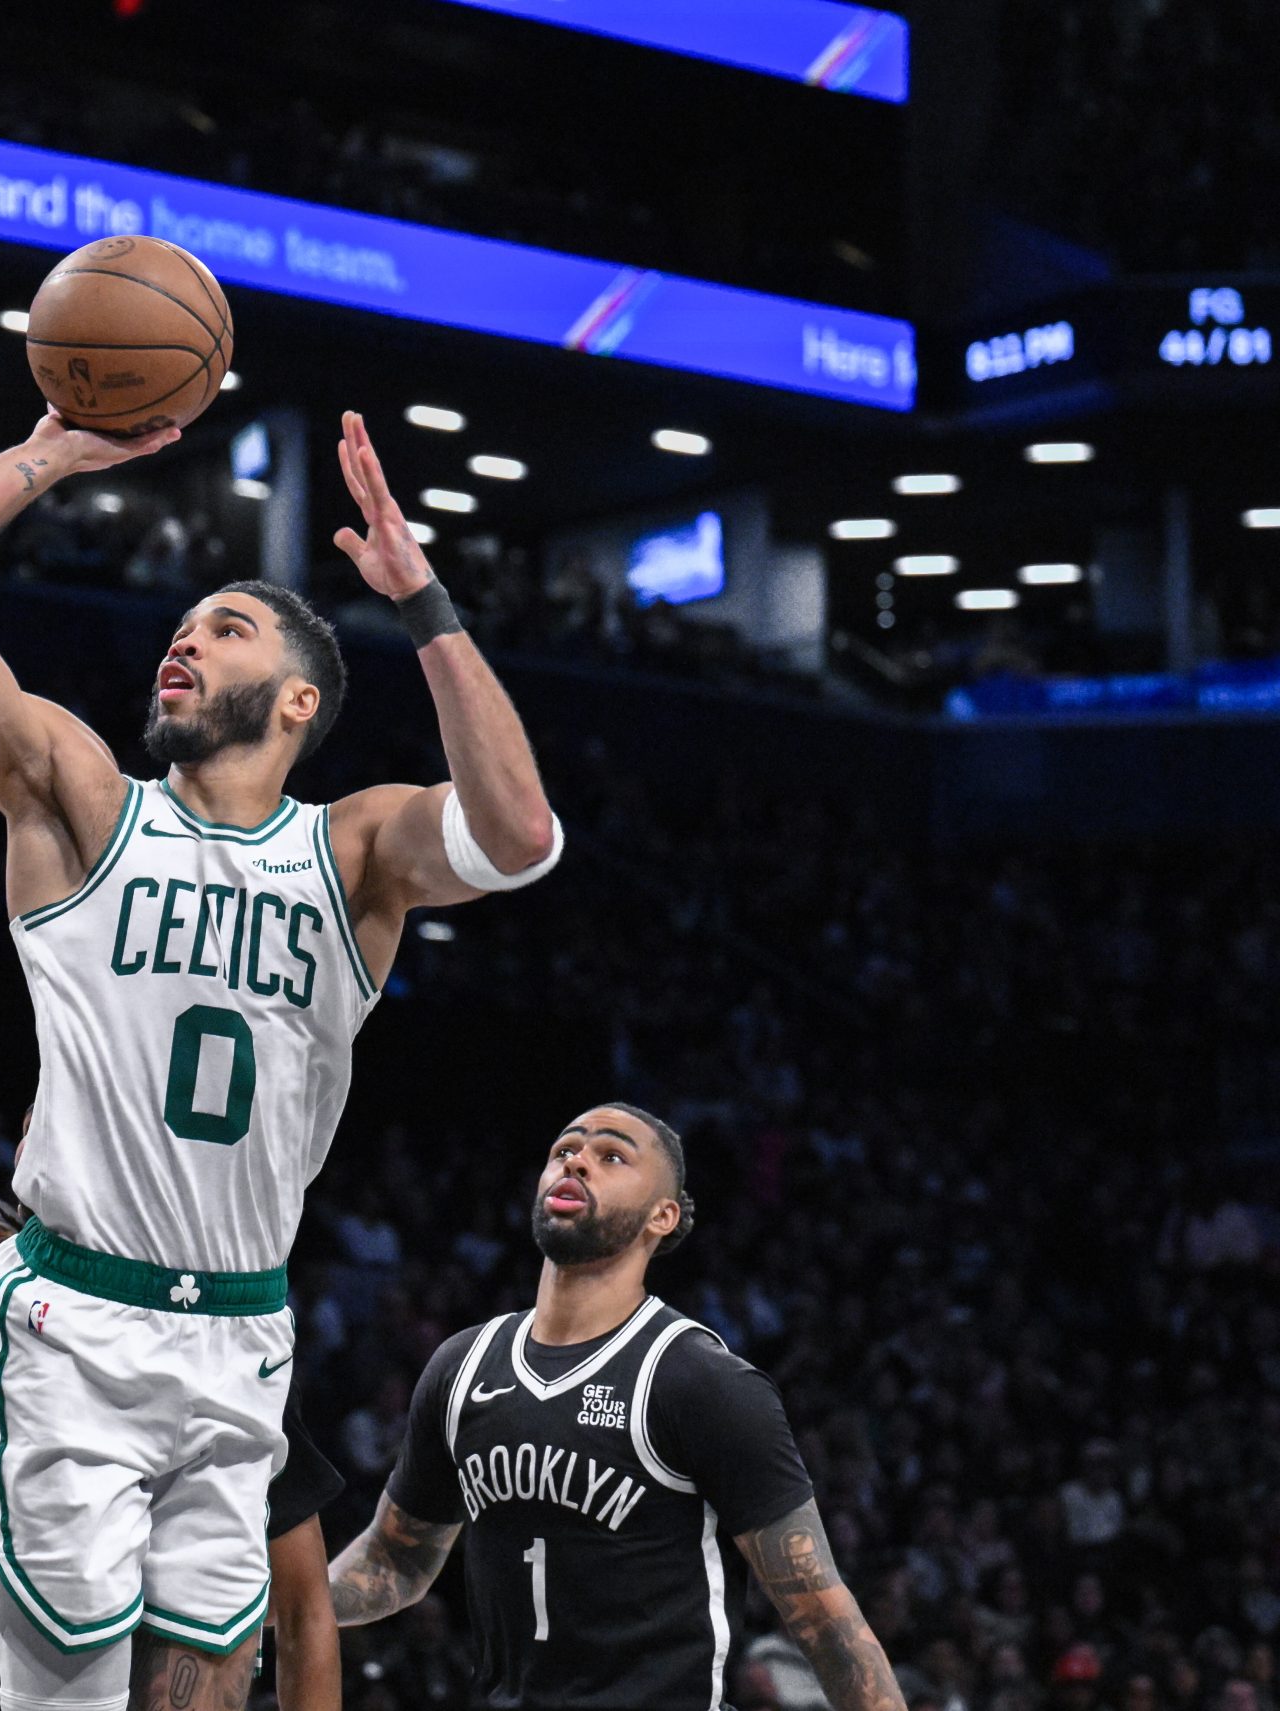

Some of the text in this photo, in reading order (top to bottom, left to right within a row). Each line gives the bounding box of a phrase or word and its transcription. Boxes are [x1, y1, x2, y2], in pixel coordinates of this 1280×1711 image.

[74, 181, 143, 238] the
[252, 857, 313, 875] Amica
[110, 876, 324, 1009] CELTICS
[163, 1004, 257, 1145] 0
[577, 1411, 626, 1429] GUIDE
[582, 1397, 626, 1415] YOUR
[583, 1384, 614, 1399] GET
[458, 1443, 646, 1531] BROOKLYN
[523, 1537, 549, 1641] 1
